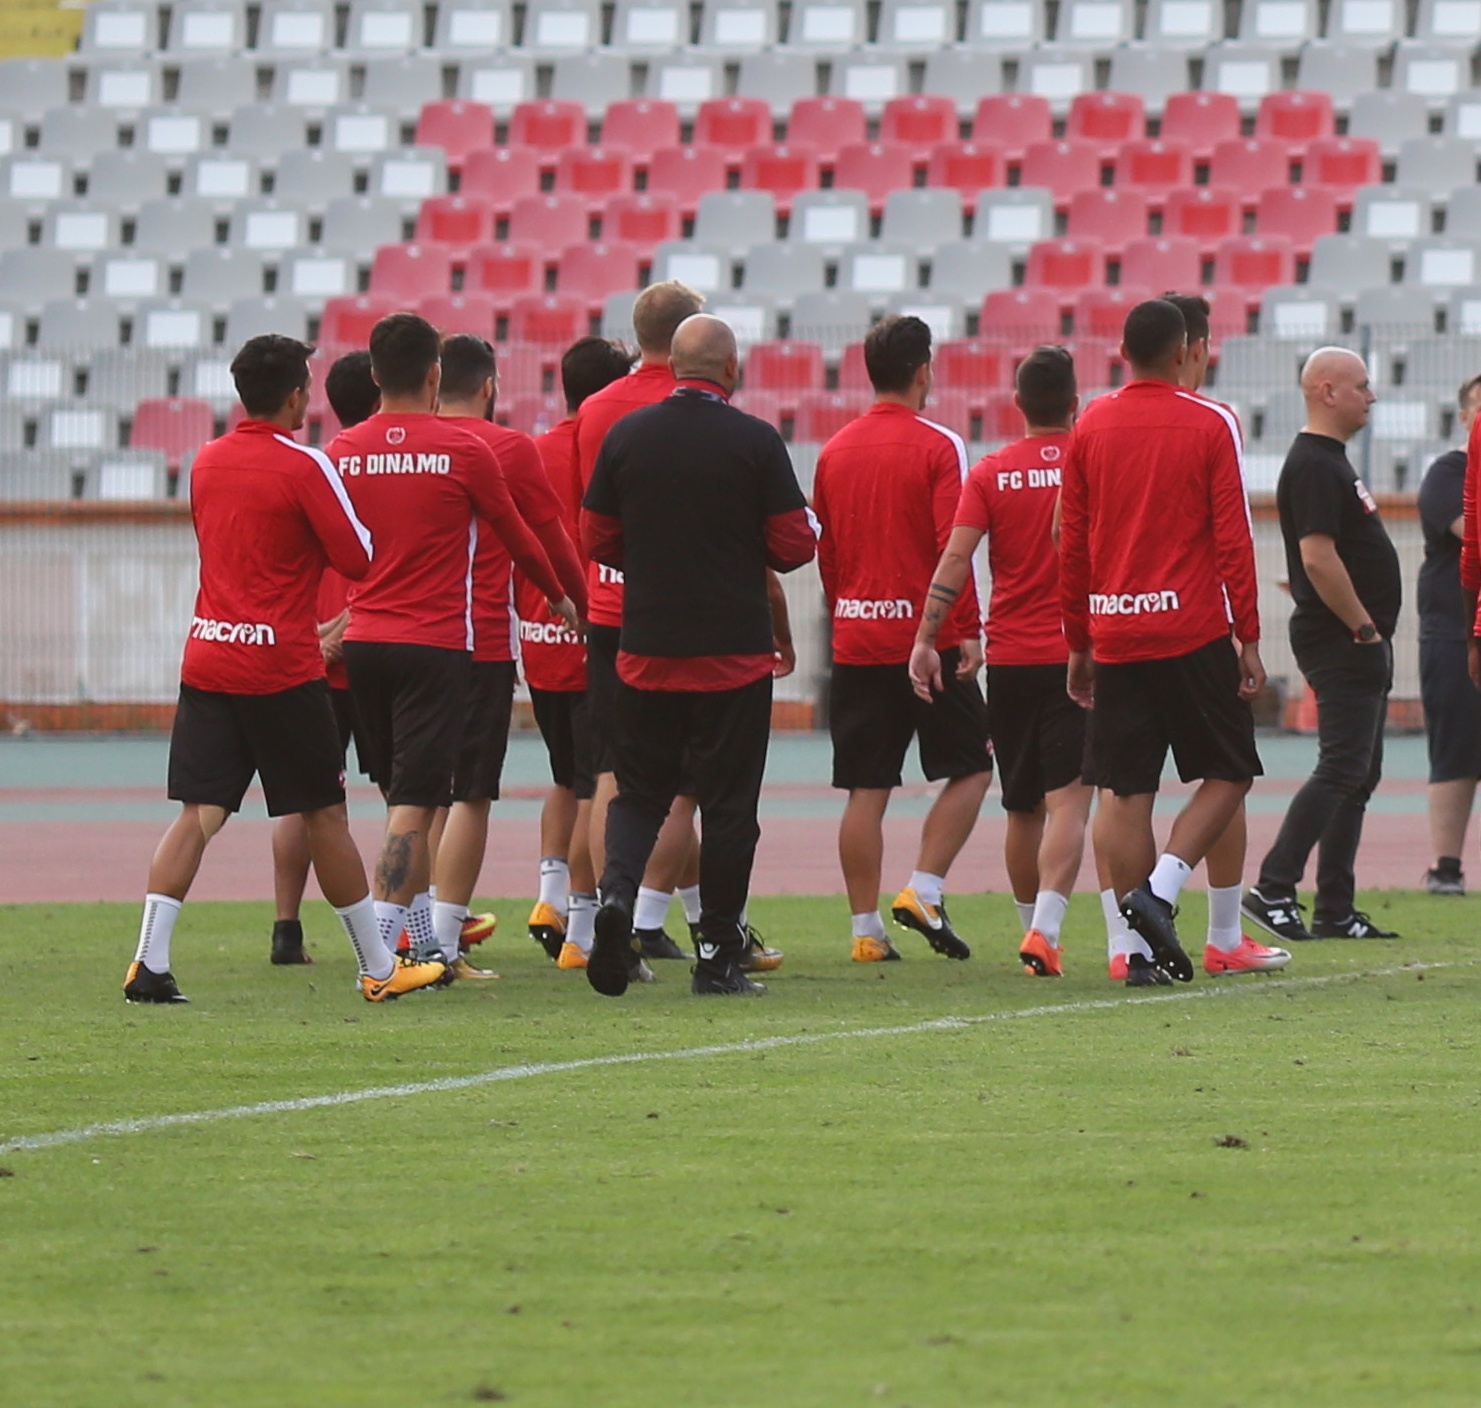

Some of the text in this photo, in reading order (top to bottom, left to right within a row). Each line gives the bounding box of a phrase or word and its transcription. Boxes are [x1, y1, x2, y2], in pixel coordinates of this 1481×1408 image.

[338, 453, 450, 477] FC DINAMO
[997, 468, 1061, 491] FC DIN
[834, 598, 913, 620] macron
[1088, 590, 1179, 615] macron
[192, 616, 275, 645] macron
